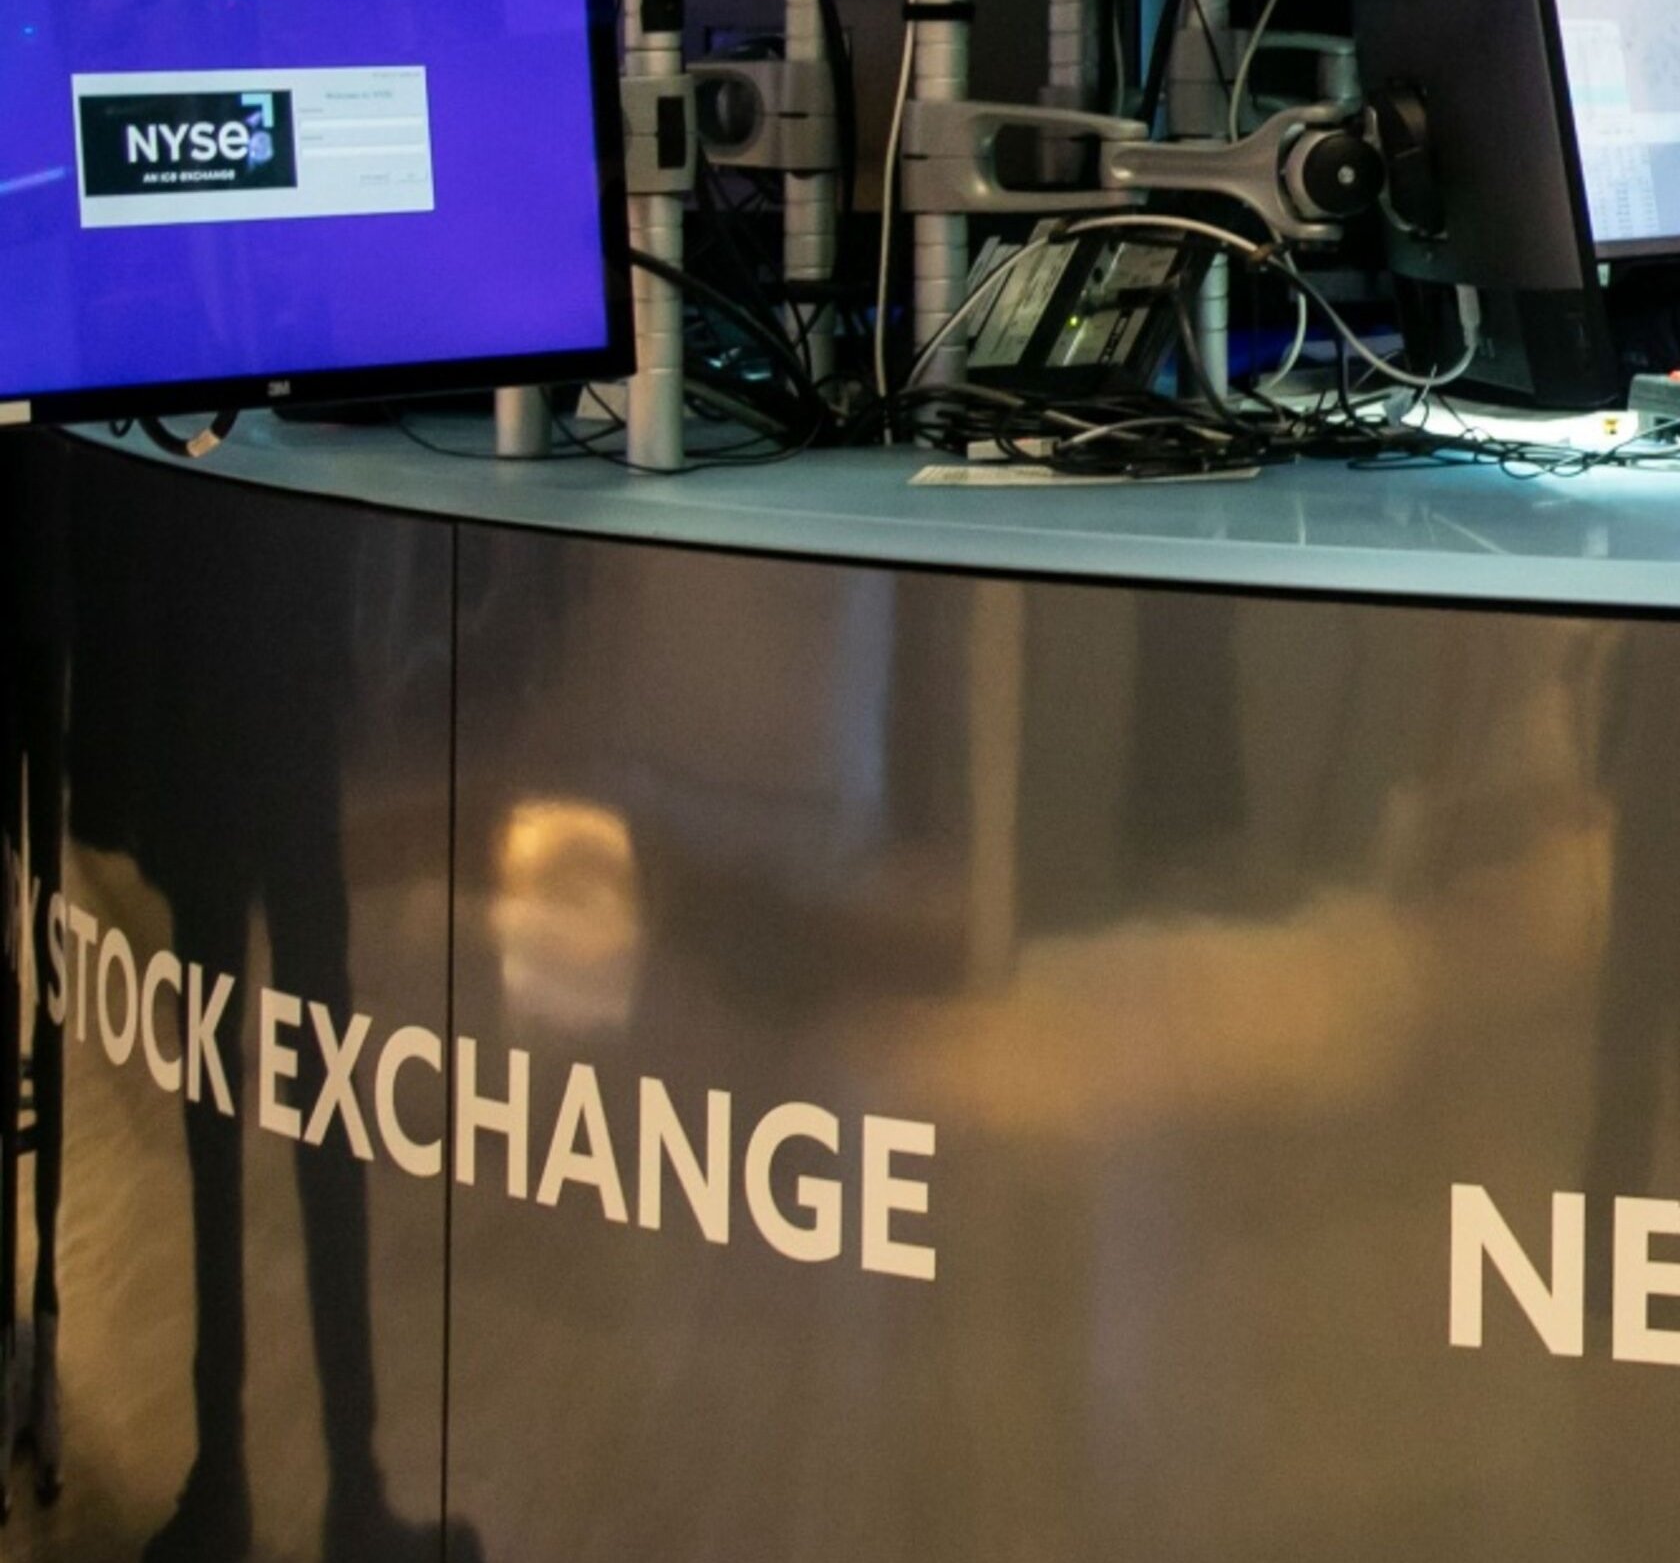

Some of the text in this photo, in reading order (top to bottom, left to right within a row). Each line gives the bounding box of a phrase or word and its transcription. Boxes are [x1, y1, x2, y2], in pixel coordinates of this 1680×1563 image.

[268, 380, 290, 397] 3M
[47, 892, 234, 1117] STOCK
[259, 985, 935, 1280] EXCHANGE
